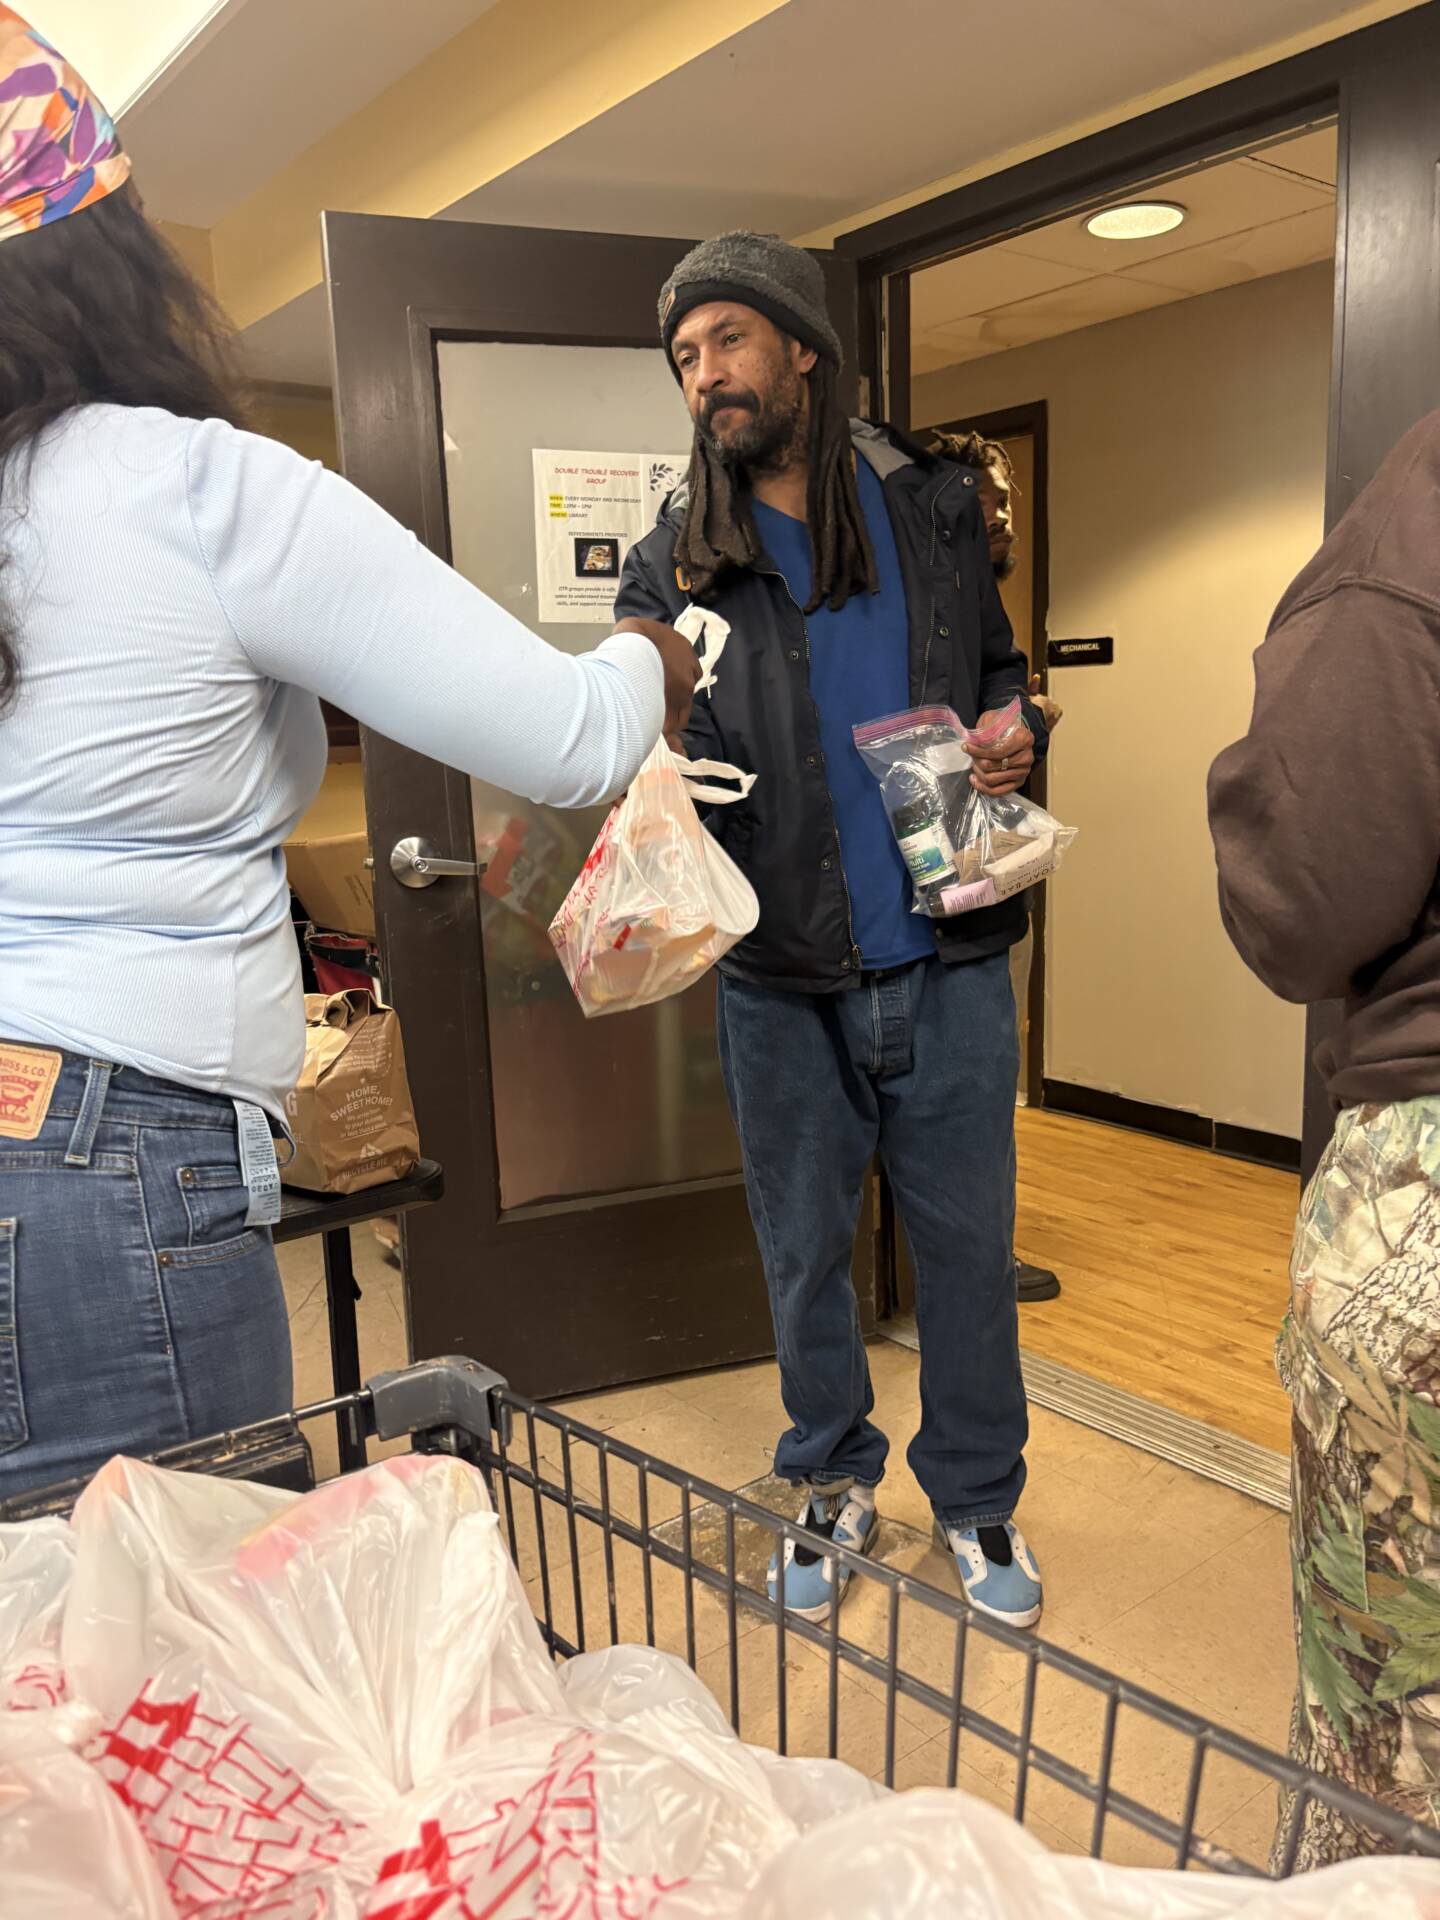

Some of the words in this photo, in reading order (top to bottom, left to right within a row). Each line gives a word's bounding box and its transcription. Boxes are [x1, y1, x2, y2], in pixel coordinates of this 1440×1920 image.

[554, 467, 578, 475] DOUBLE
[581, 468, 607, 476] TROUBLE
[609, 469, 640, 477] RECOVERY
[1060, 642, 1100, 653] MECHANICAL
[345, 1085, 380, 1101] HOME,
[330, 1099, 364, 1122] SWEET
[365, 1096, 393, 1106] HOME!
